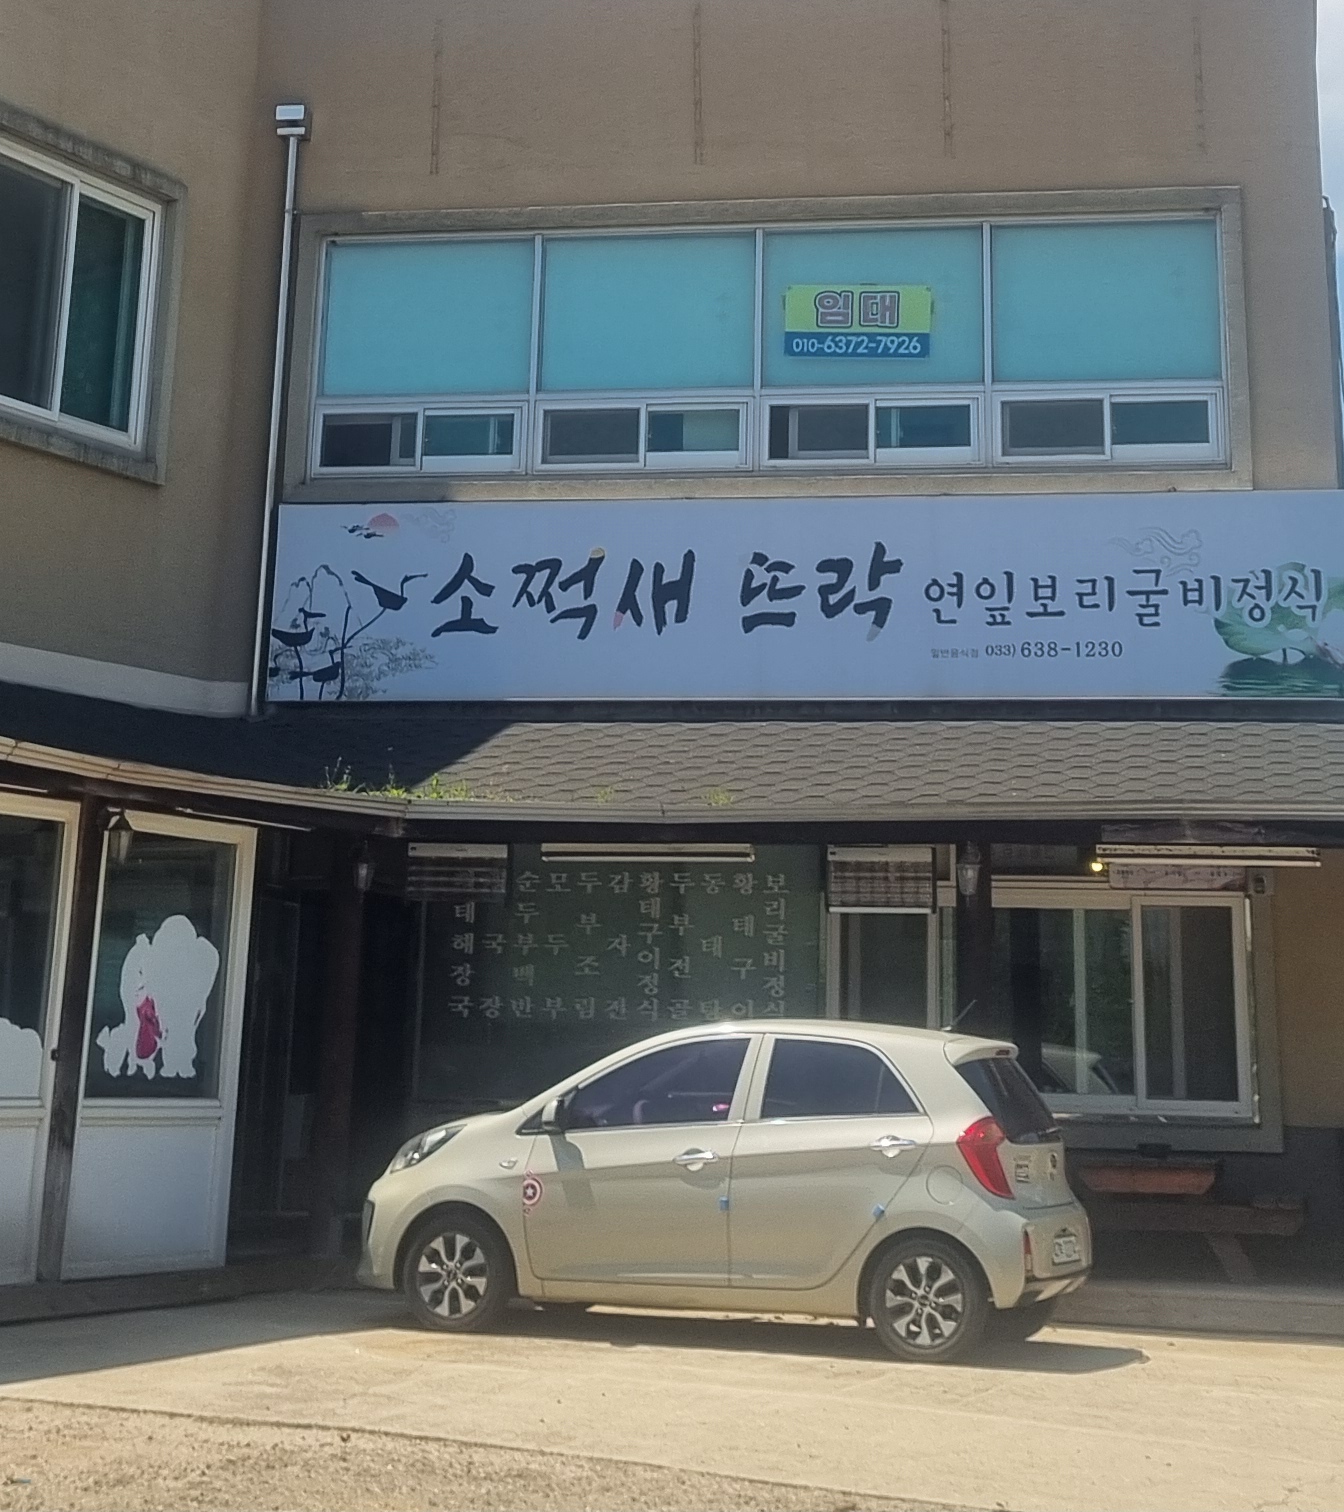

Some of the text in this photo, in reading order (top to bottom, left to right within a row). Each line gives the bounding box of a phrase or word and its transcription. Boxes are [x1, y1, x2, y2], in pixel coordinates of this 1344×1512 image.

[814, 290, 901, 329] 임대
[792, 335, 922, 355] 010-6372-7926
[430, 540, 1328, 643] 소쩍새 뜨락 연잎보리굴비정식
[1019, 640, 1124, 659] 638-1230
[448, 901, 476, 1019] 태해장국
